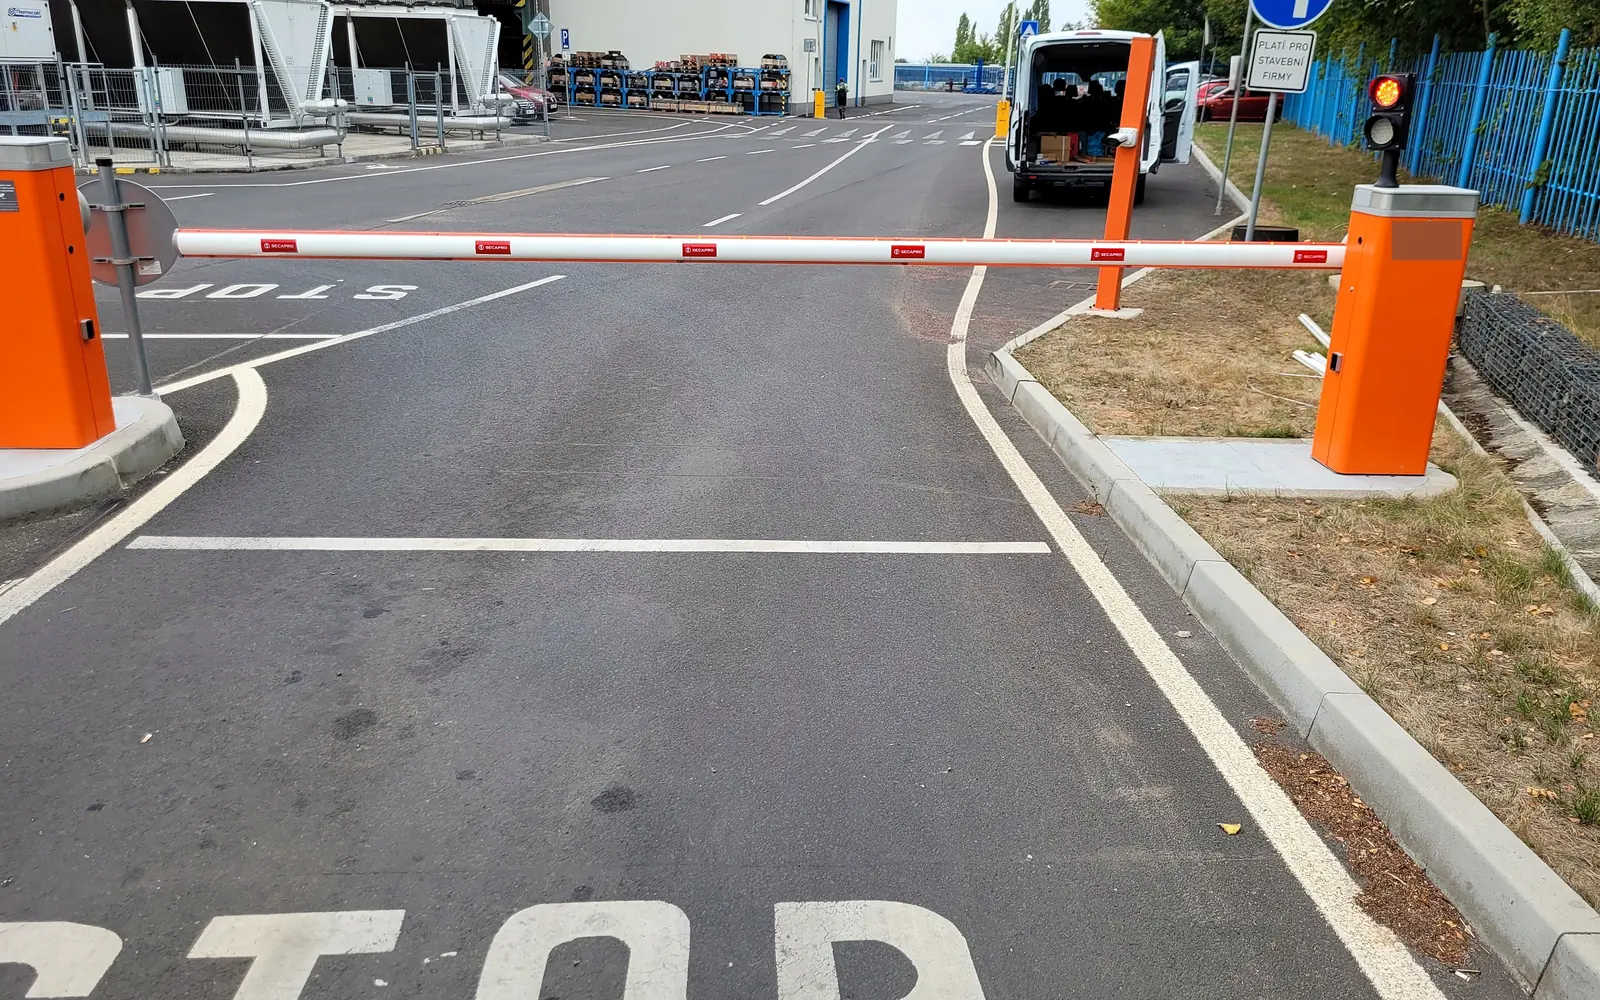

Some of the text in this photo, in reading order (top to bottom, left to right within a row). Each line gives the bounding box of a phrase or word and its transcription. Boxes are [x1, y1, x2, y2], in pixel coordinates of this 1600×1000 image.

[1258, 40, 1309, 51] PLATÍ PRO
[1258, 56, 1305, 66] STAVEBNÍ
[1262, 72, 1292, 81] FIRMY
[134, 281, 418, 300] STOP
